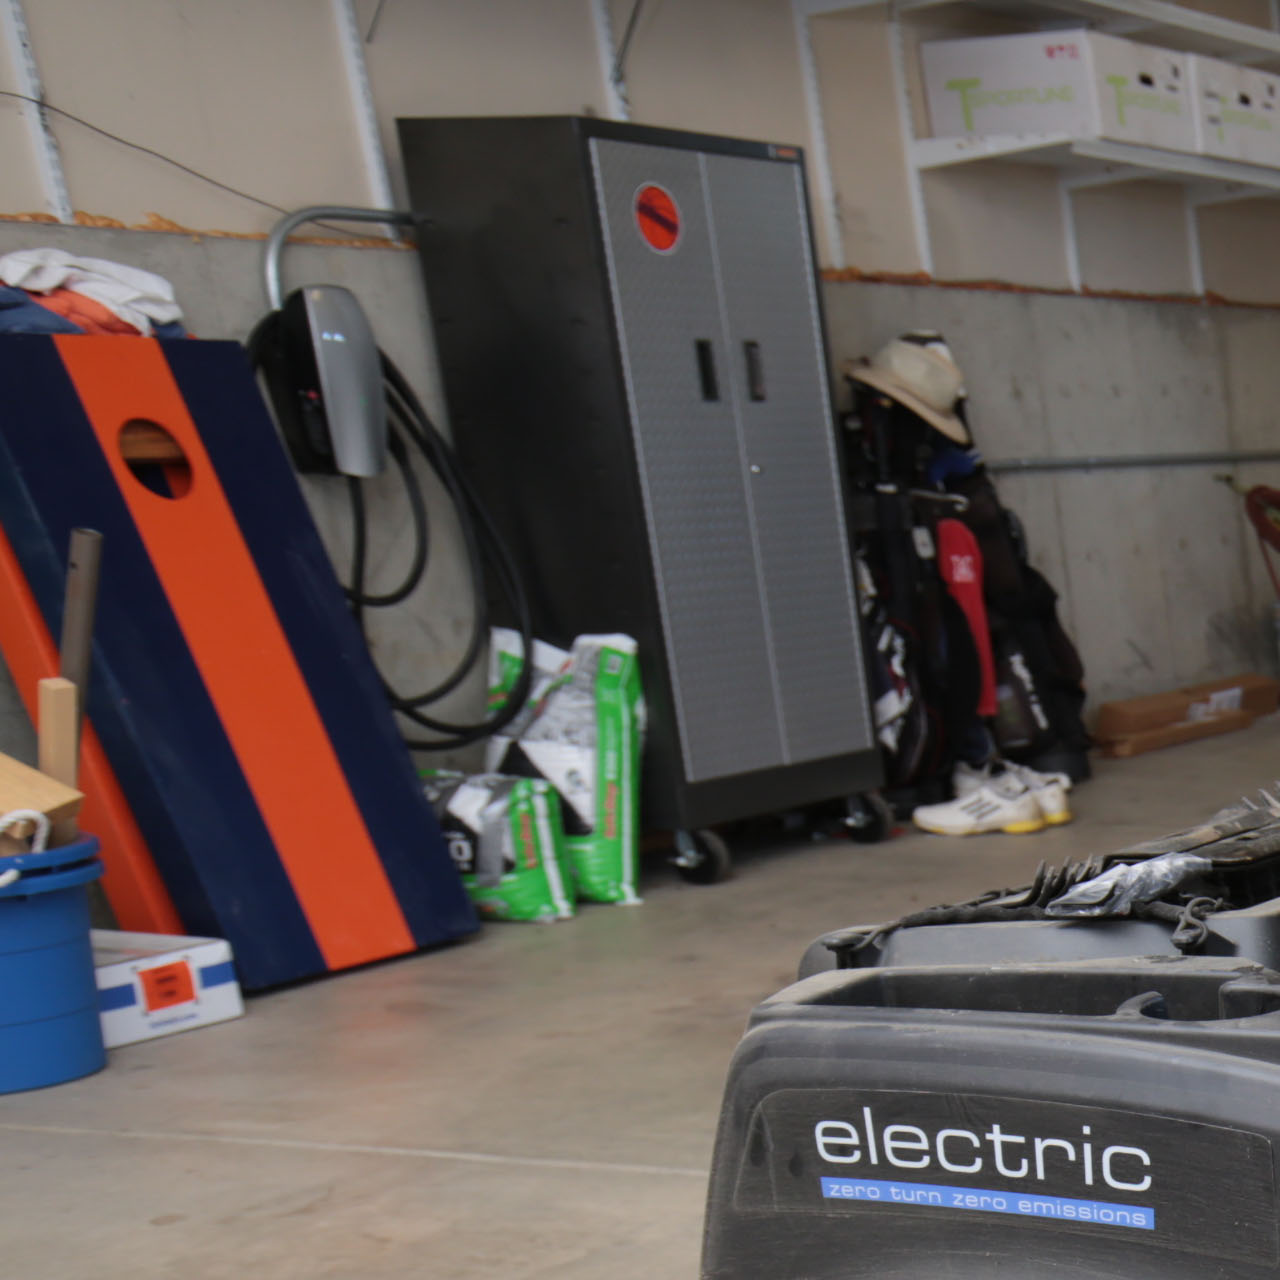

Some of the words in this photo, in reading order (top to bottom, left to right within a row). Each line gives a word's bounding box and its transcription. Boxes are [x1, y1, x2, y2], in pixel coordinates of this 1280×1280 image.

[814, 1106, 1152, 1191] electric
[829, 1183, 880, 1200] zero
[889, 1186, 942, 1204] turn
[952, 1192, 1007, 1210] zero
[1018, 1199, 1147, 1226] emissions
